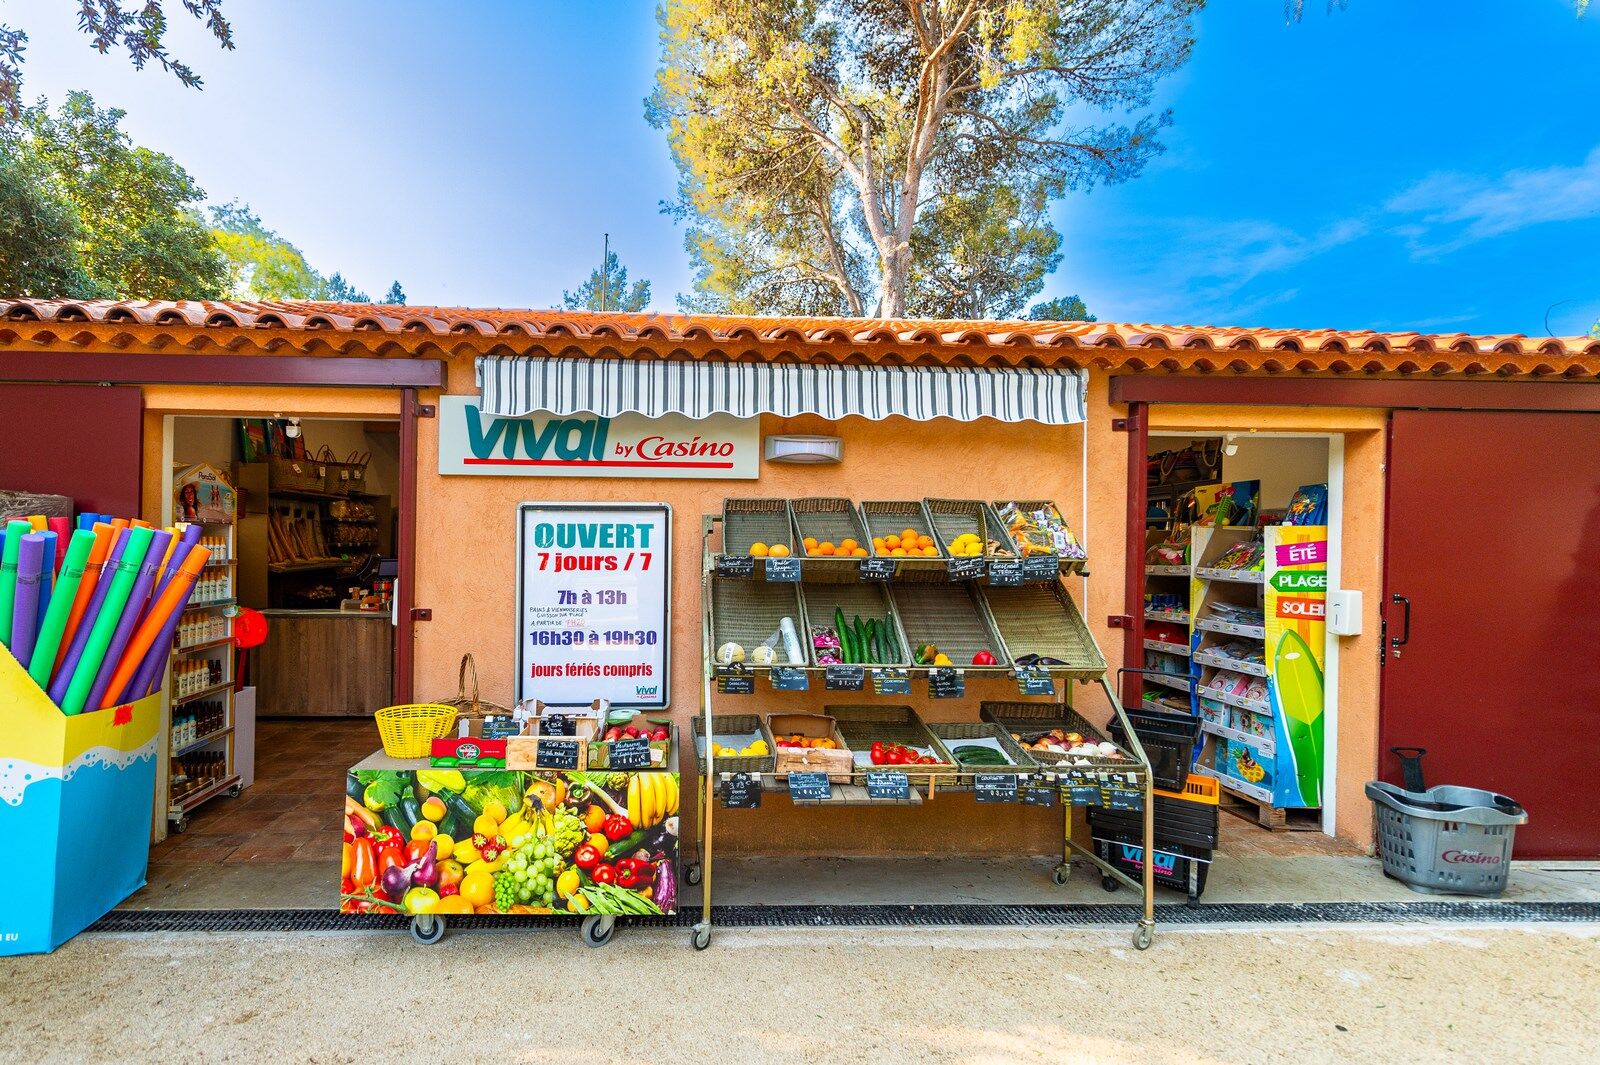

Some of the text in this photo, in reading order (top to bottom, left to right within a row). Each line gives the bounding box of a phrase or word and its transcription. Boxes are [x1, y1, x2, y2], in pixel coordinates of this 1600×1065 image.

[465, 405, 734, 461] Vival by Casino
[534, 522, 655, 549] OUVERT
[1289, 543, 1318, 562] ÉTÉ
[537, 552, 652, 573] 7 jours / 7
[1279, 575, 1328, 588] PLAGE
[557, 590, 627, 604] 7h à 13h
[530, 630, 657, 646] 16h30 à 19h30
[530, 662, 652, 678] jours fériés compris
[636, 686, 658, 694] Vival
[1122, 845, 1176, 868] Vial
[1442, 850, 1500, 864] Casino
[6, 933, 18, 941] EU
